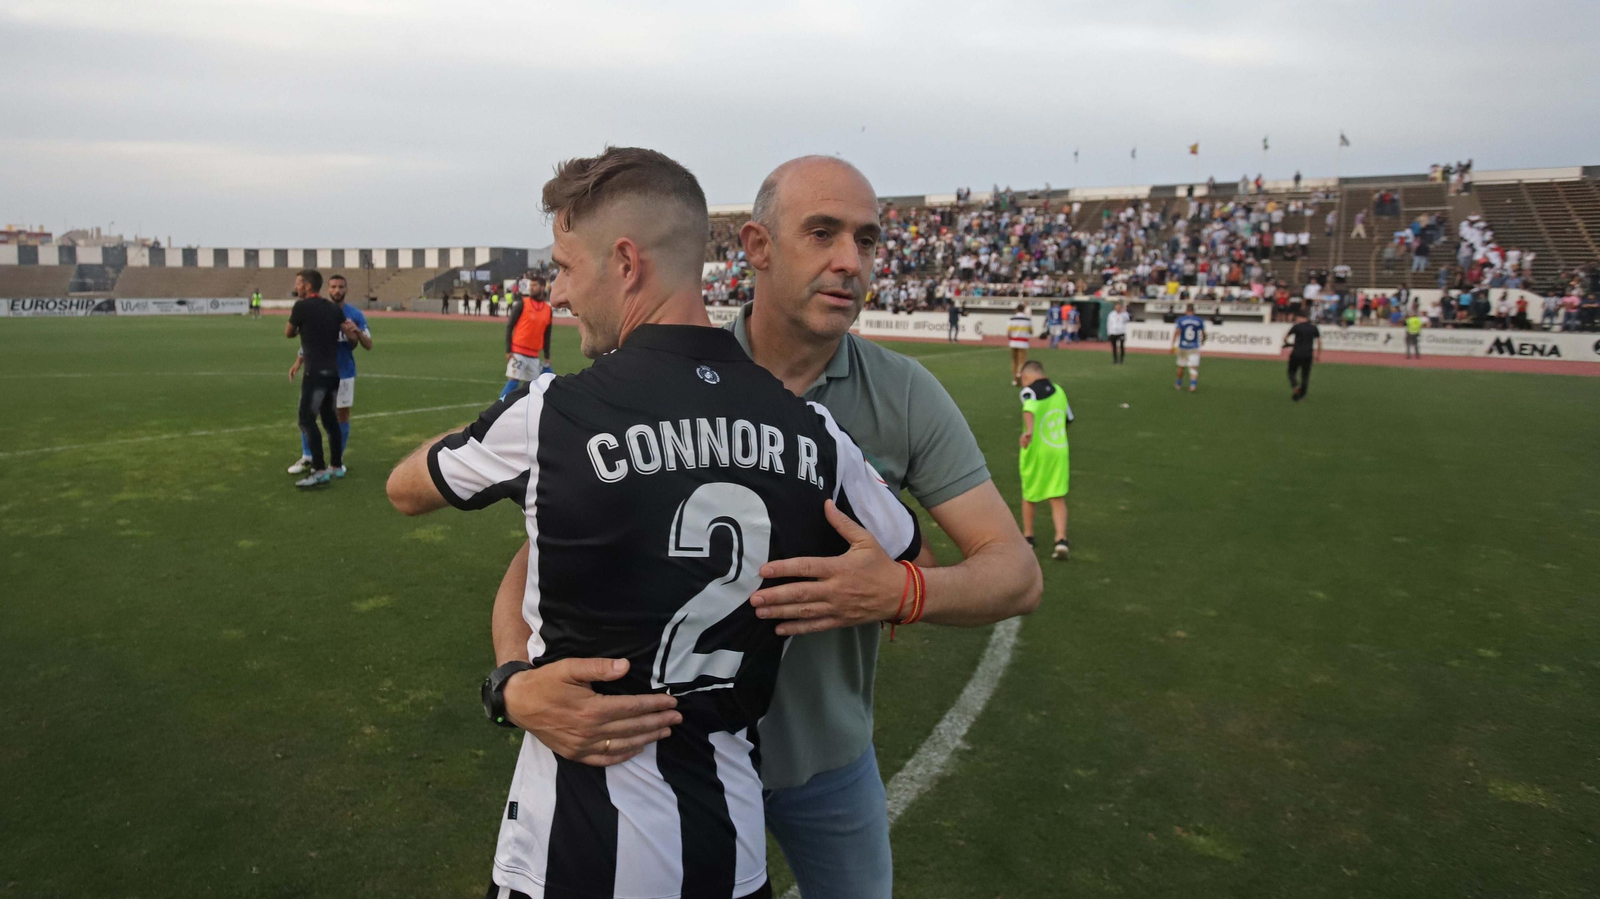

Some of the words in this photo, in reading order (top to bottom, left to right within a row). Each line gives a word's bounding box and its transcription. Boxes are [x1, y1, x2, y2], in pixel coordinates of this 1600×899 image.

[10, 299, 95, 311] EUROSHIP
[121, 301, 148, 312] West
[865, 319, 893, 329] PRIMERA
[1131, 329, 1170, 341] PRIMERA
[1205, 331, 1273, 346] Footters
[1184, 325, 1196, 341] 6
[1487, 336, 1562, 358] MENA
[511, 359, 522, 370] 22
[586, 417, 786, 484] CONNOR
[797, 434, 825, 491] R.
[651, 482, 772, 697] 2
